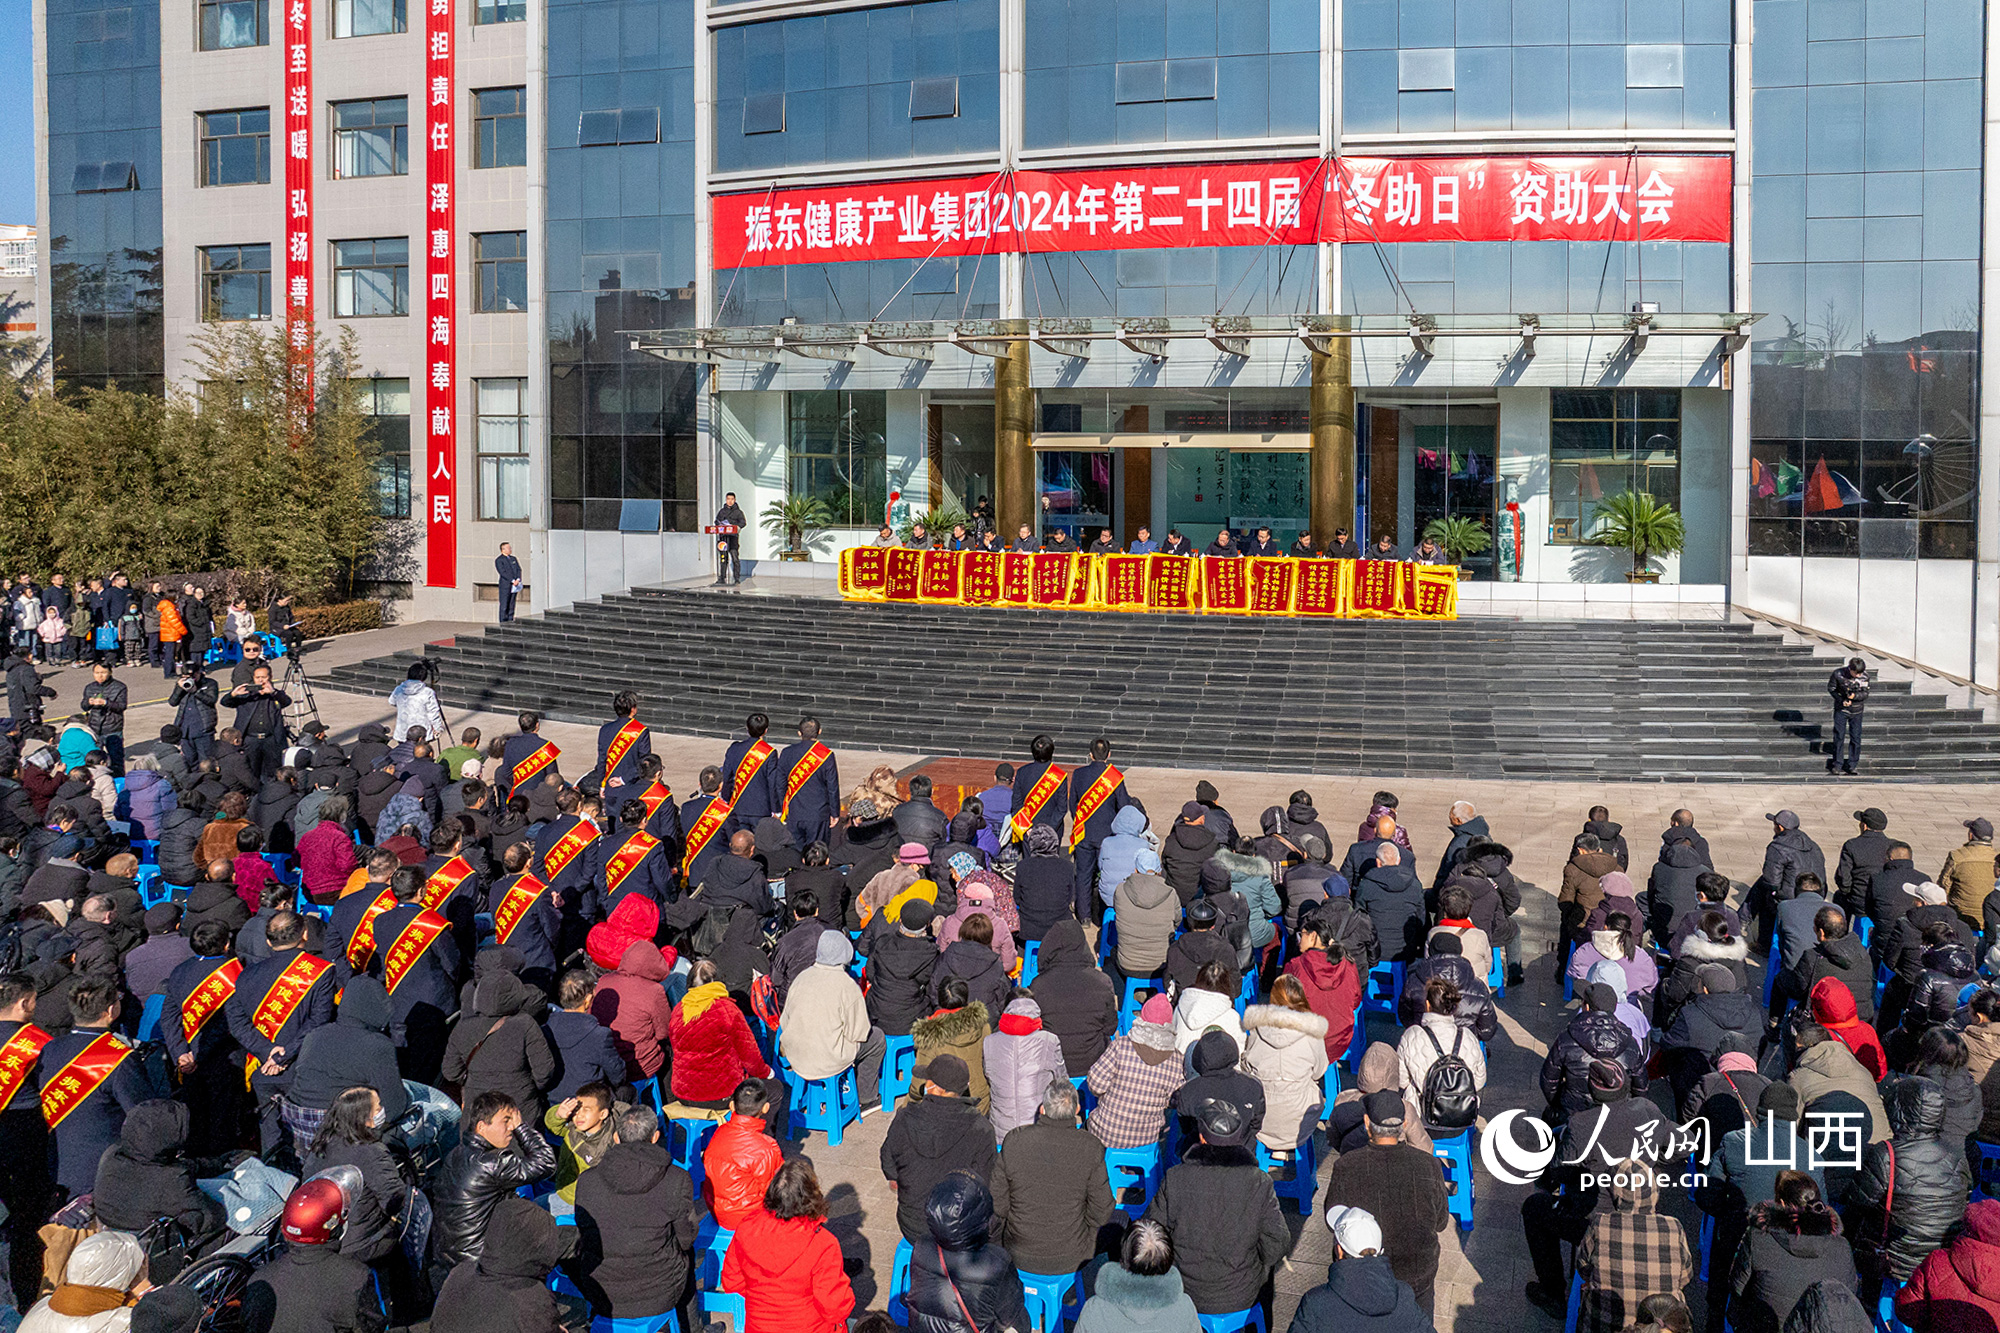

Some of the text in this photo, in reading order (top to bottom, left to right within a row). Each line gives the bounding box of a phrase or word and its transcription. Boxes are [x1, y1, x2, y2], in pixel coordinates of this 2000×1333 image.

[290, 1, 308, 160] 冬至送暖
[431, 184, 452, 524] 泽惠四海奉献人民
[495, 890, 527, 944] 振东健康产
[0, 1037, 37, 1096] 振东健
